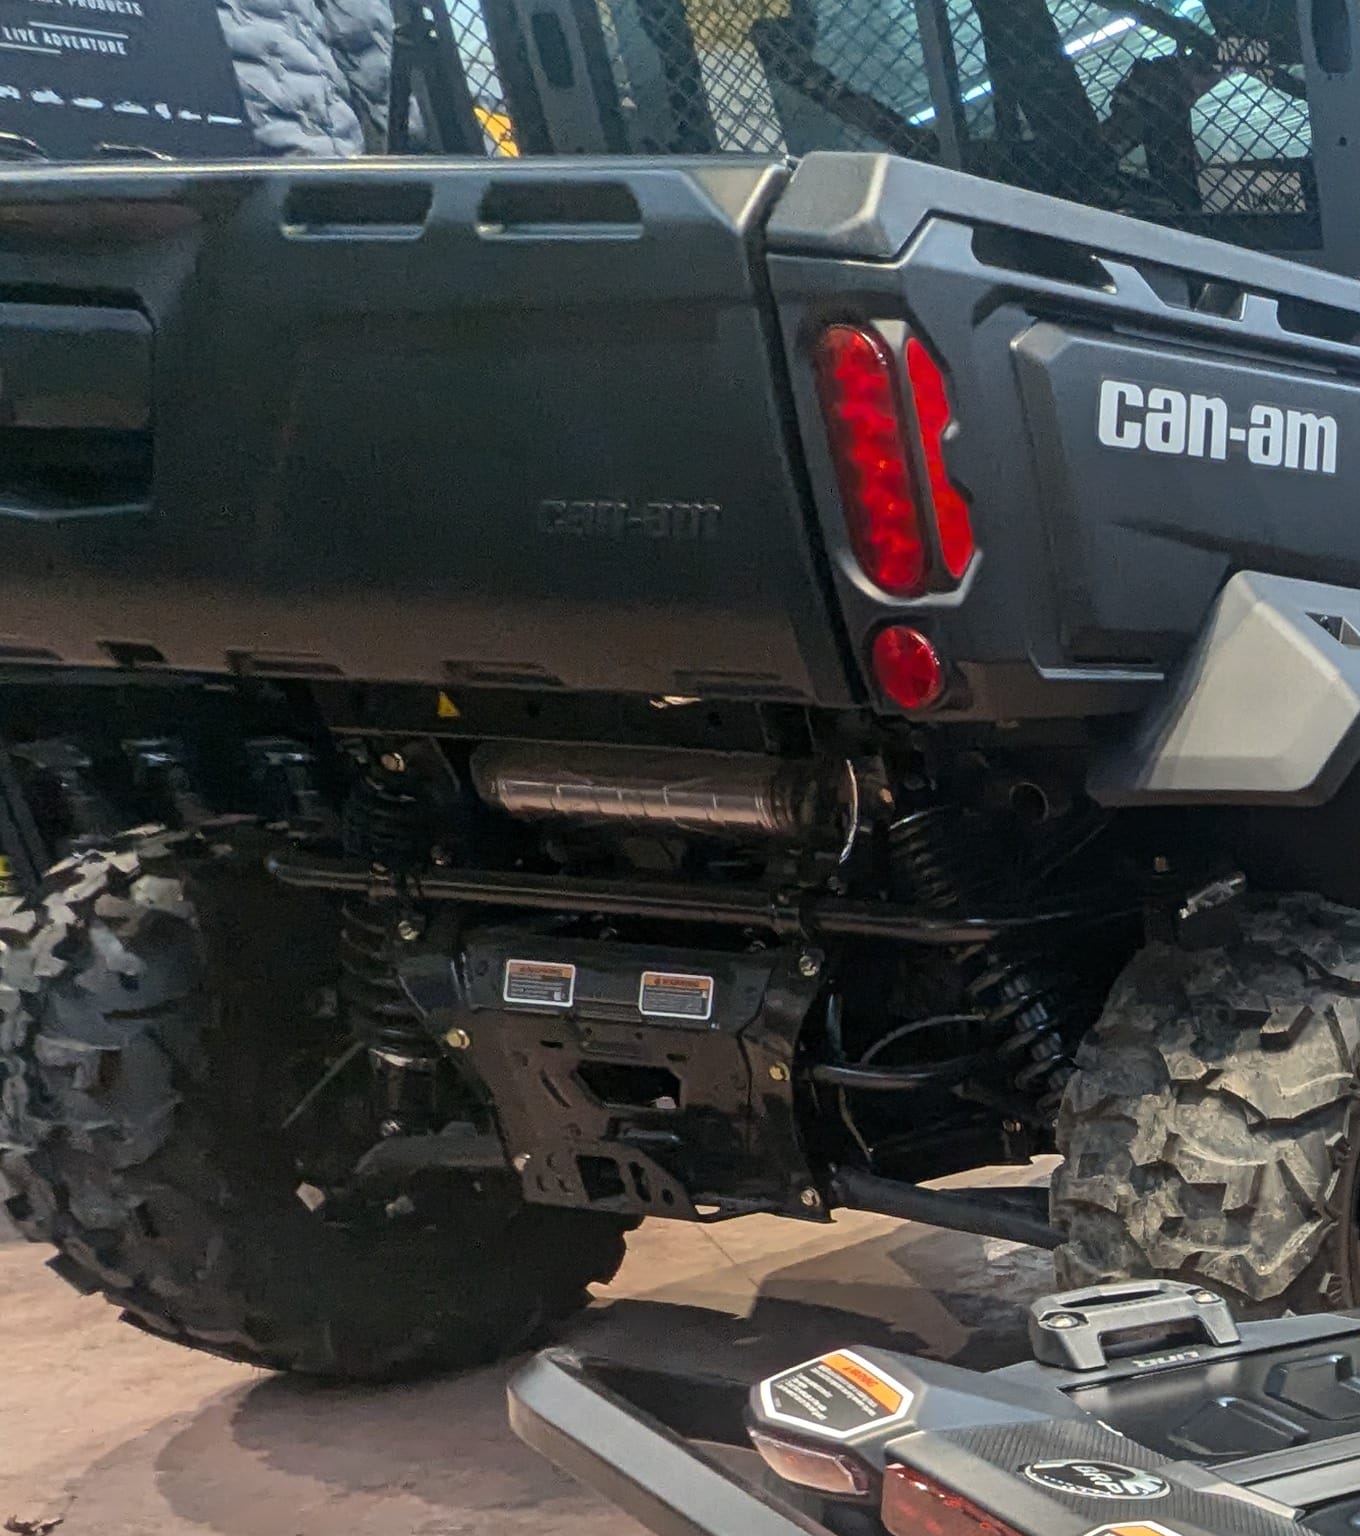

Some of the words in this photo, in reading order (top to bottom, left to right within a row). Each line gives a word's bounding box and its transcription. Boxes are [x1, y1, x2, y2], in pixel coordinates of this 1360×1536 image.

[2, 27, 39, 44] LIVE
[43, 30, 128, 55] ADVENTURE
[1098, 378, 1337, 474] can-am
[1071, 1464, 1125, 1495] BRP
